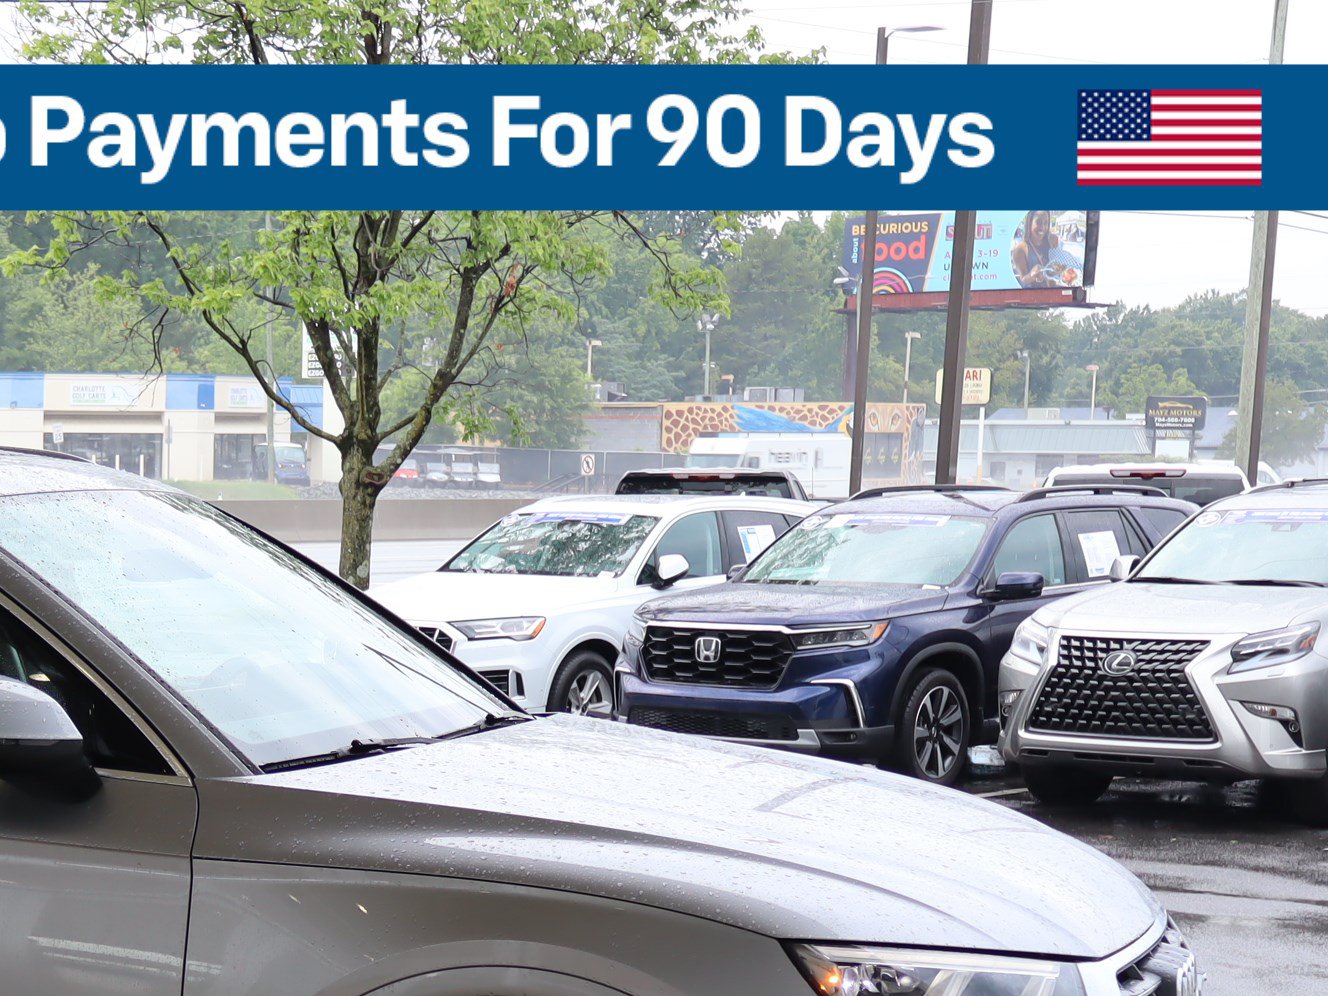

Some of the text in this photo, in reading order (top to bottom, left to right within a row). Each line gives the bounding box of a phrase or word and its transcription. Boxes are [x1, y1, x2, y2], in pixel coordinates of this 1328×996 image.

[851, 224, 866, 236] BE
[851, 237, 859, 264] about
[861, 234, 927, 262] ood
[72, 385, 106, 393] CHARLOTTE
[1169, 409, 1202, 417] MOTORS
